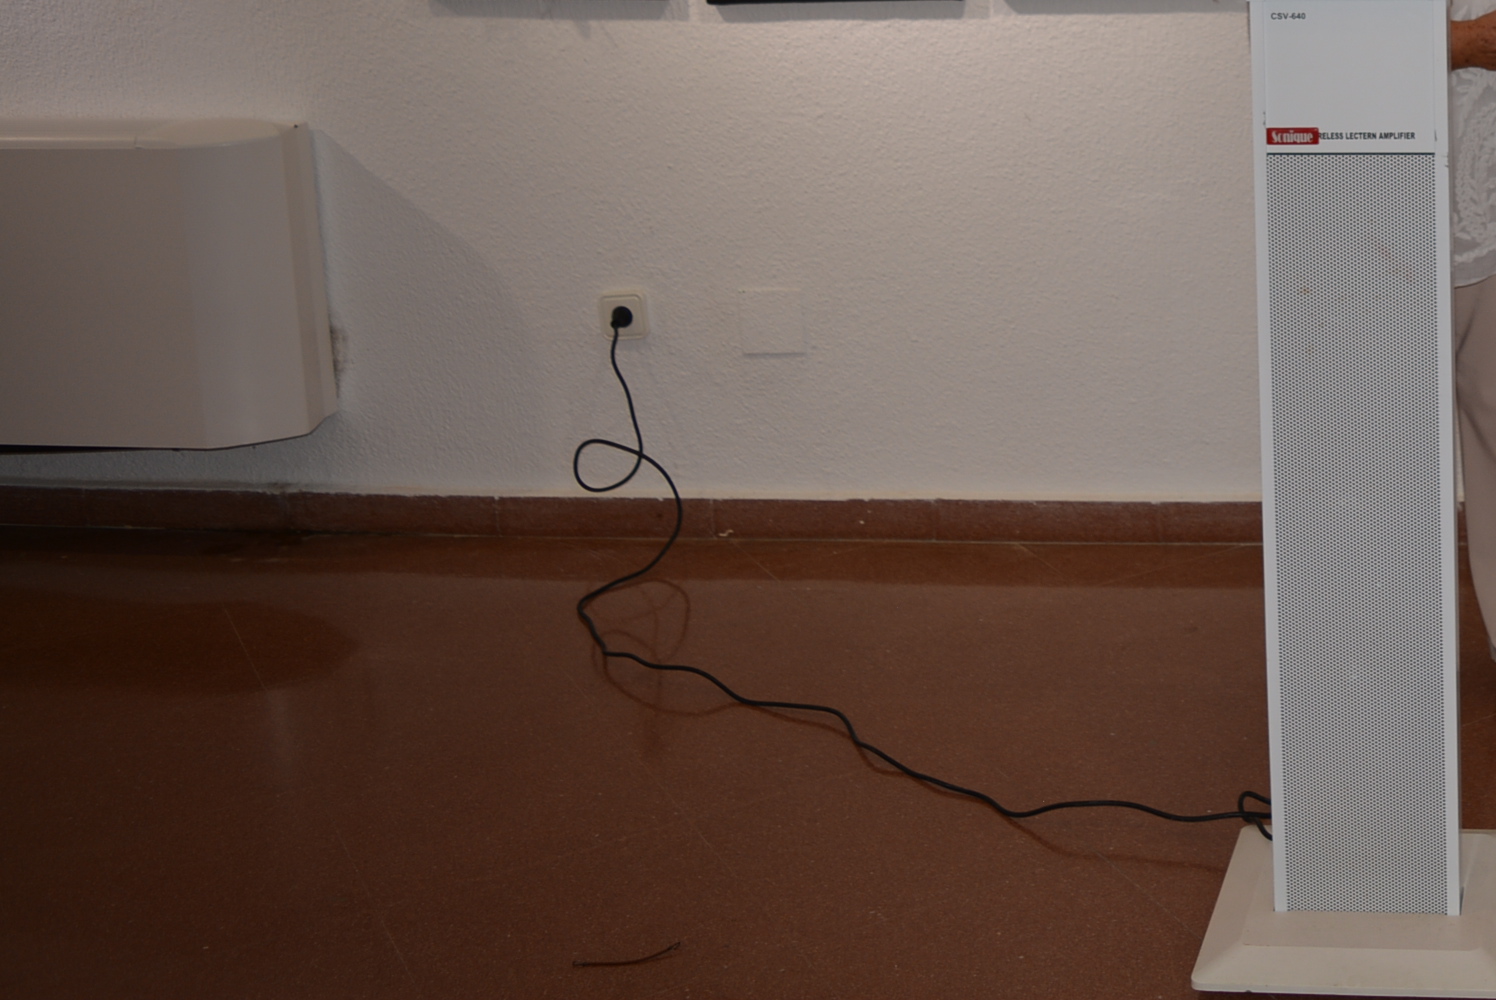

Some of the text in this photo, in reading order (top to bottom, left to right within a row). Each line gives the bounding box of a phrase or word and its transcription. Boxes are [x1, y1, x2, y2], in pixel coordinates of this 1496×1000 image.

[1270, 12, 1306, 20] CSV-640
[1271, 130, 1314, 143] Sonique
[1345, 132, 1377, 140] LECTERN
[1378, 132, 1416, 140] AMPLIFIER
